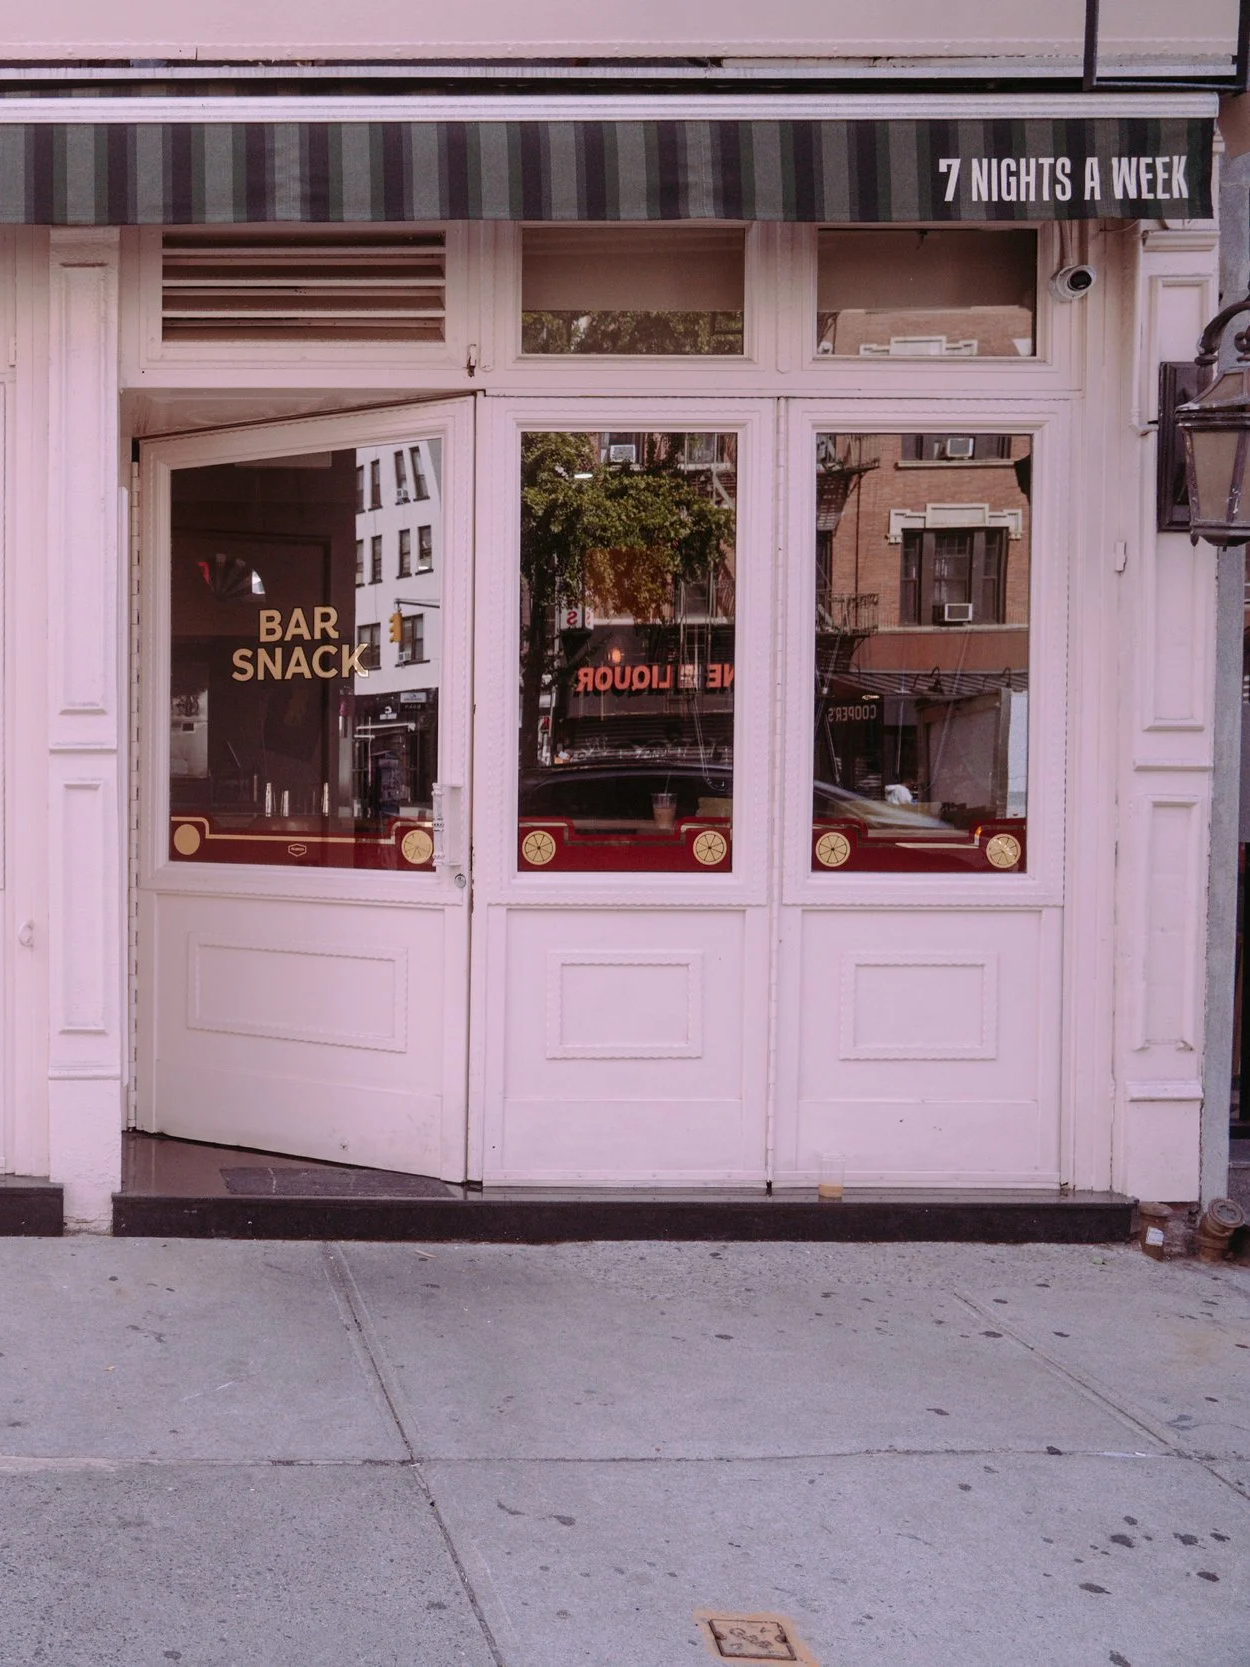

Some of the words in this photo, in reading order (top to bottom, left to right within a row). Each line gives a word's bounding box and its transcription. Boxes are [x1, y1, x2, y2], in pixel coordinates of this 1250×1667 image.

[938, 158, 961, 202] 7
[971, 157, 1072, 202] NIGHTS
[1084, 157, 1101, 200] A
[1111, 155, 1189, 200] WEEK
[259, 606, 339, 643] BAR
[231, 643, 369, 682] SNACK
